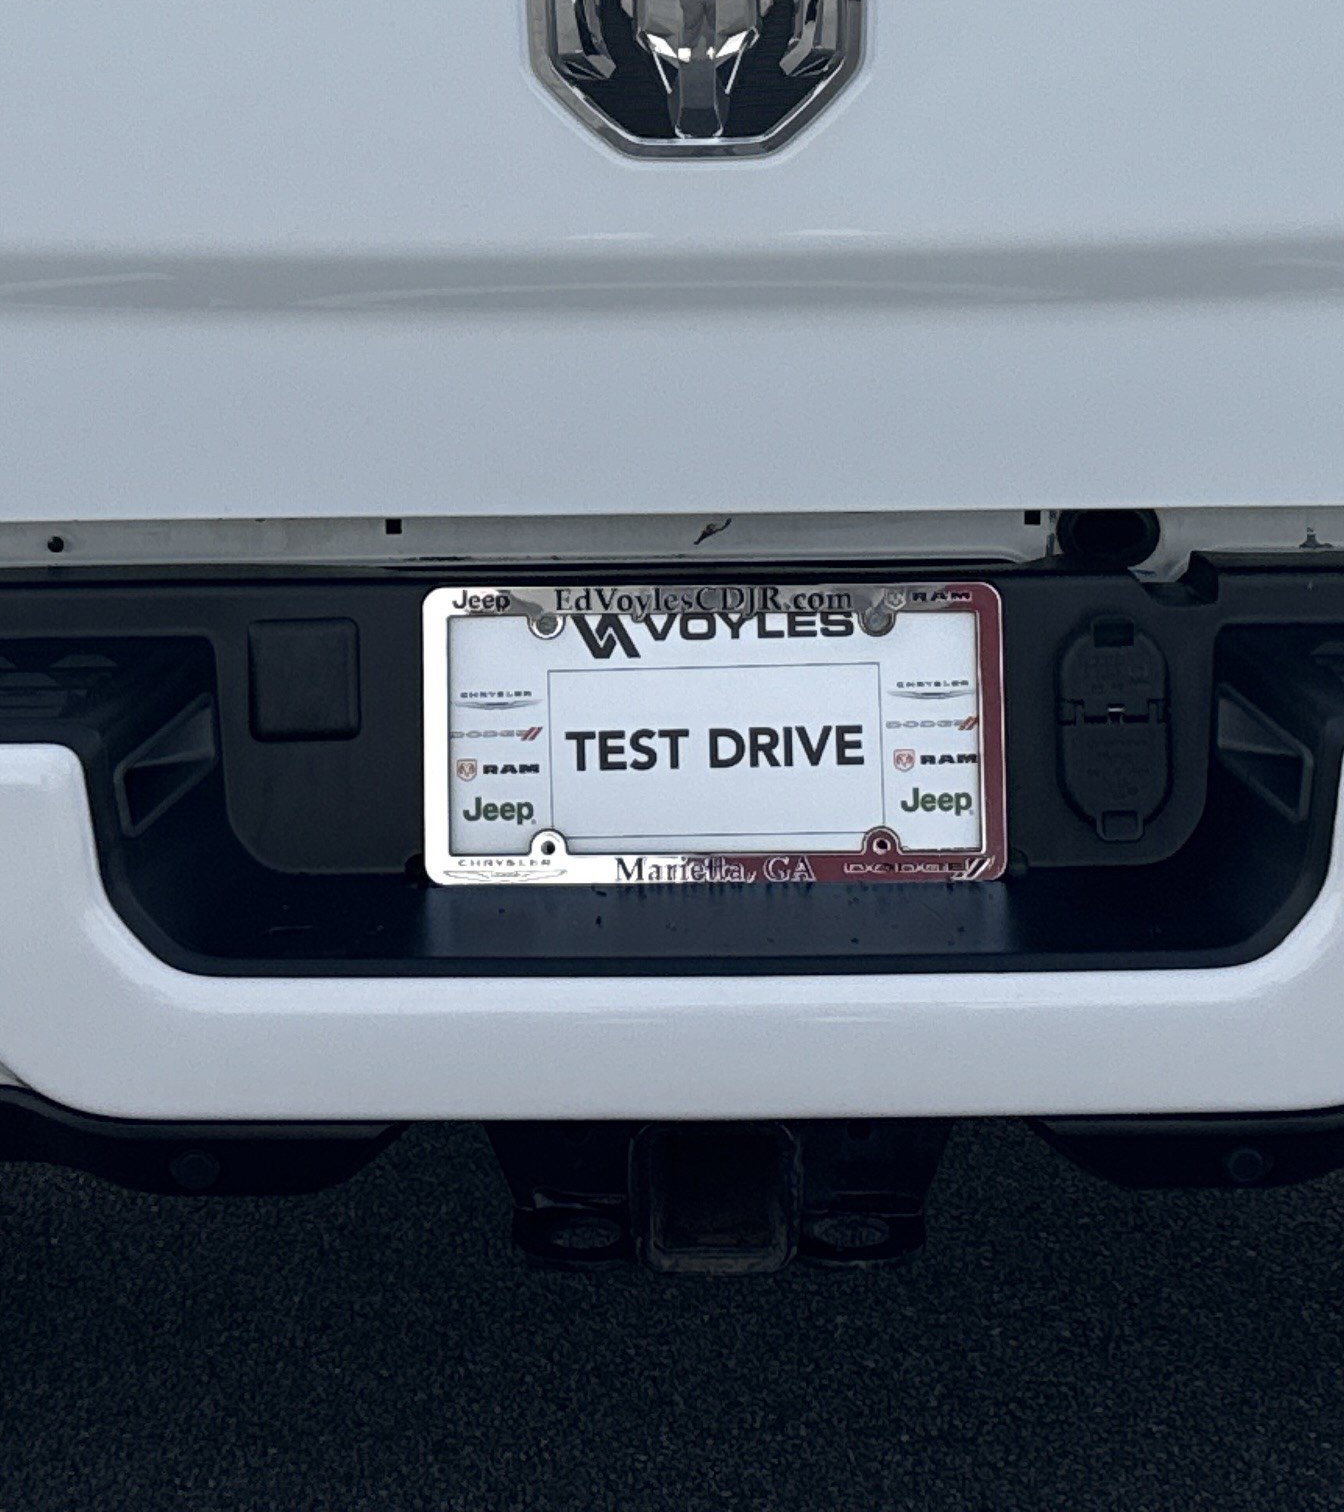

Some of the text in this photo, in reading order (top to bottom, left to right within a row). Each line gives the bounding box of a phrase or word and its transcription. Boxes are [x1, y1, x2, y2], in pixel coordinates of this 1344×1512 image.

[452, 589, 512, 612] Jeep
[555, 586, 853, 621] EdVoylesCDJR.com
[911, 591, 972, 602] RAM
[644, 611, 854, 641] VOYLES
[565, 724, 866, 772] TEST DRIVE
[920, 753, 978, 765] RAM
[483, 763, 540, 775] RAM
[463, 796, 534, 825] Jeep
[900, 787, 973, 816] Jeep
[763, 855, 817, 882] GA
